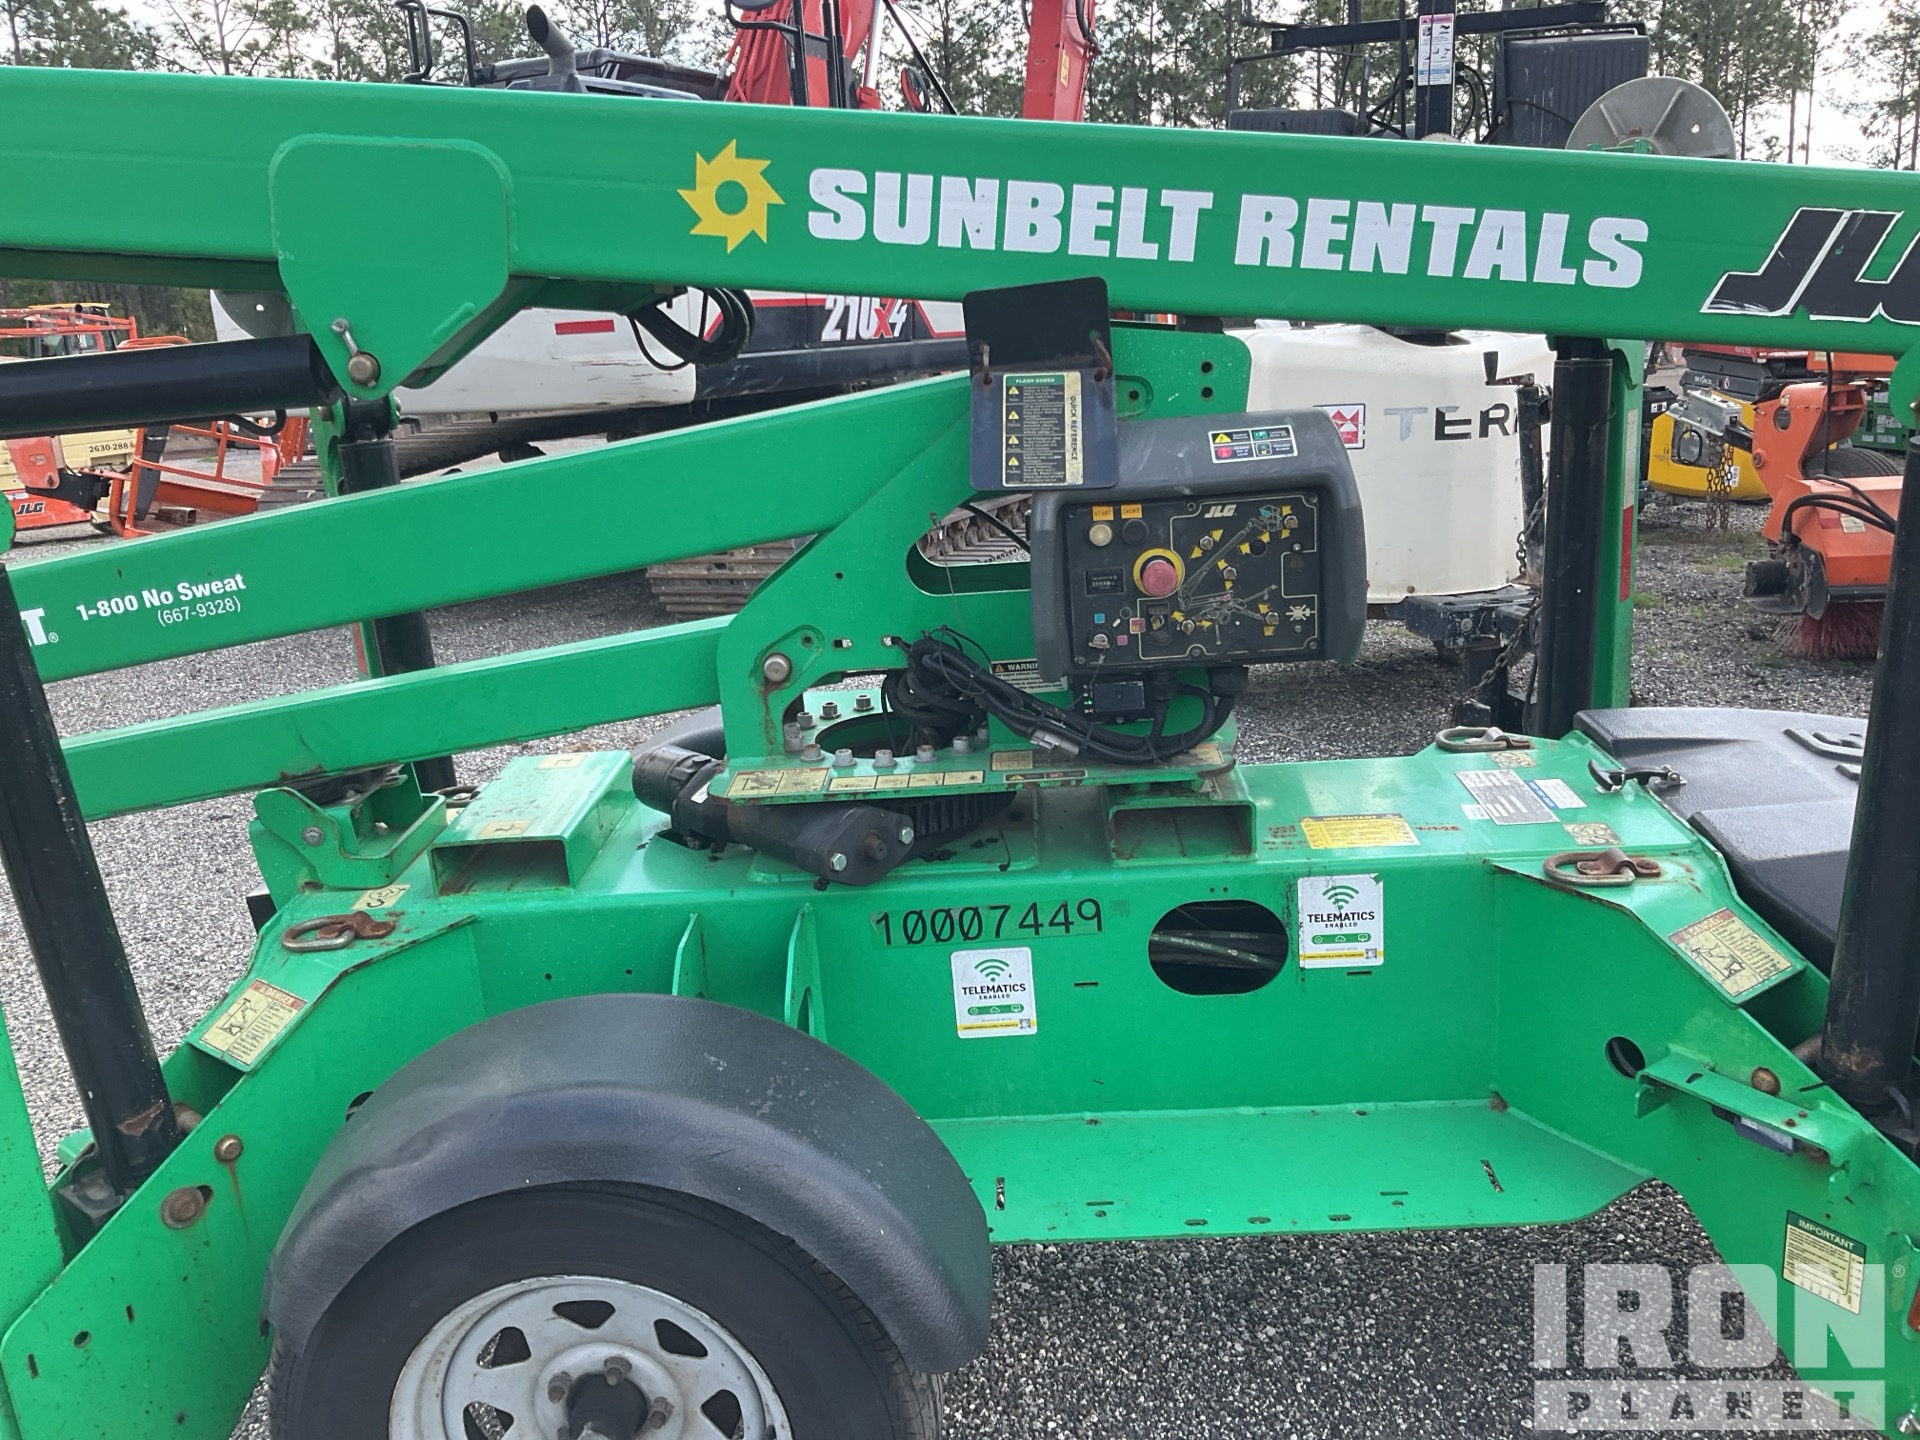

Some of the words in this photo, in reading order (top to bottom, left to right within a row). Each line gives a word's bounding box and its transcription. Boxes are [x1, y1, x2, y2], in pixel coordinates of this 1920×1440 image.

[808, 168, 1214, 263] SUNBELT
[1234, 193, 1649, 289] RENTALS
[1699, 206, 1920, 326] JL
[1384, 403, 1518, 441] TER
[1070, 420, 1078, 461] REFERENCE
[16, 501, 45, 515] JLG
[1204, 504, 1237, 518] JLG
[76, 594, 139, 621] 1-800
[141, 588, 174, 609] No
[176, 573, 247, 601] Sweat
[157, 595, 241, 627] (667-9328)
[875, 897, 1103, 946] 10007449
[1307, 911, 1375, 923] TELEMATICS
[1691, 915, 1724, 935] DANGER
[265, 986, 296, 1006] DANGER
[962, 983, 1026, 995] TELEMATICS
[1798, 1219, 1855, 1250] IMPORTANT
